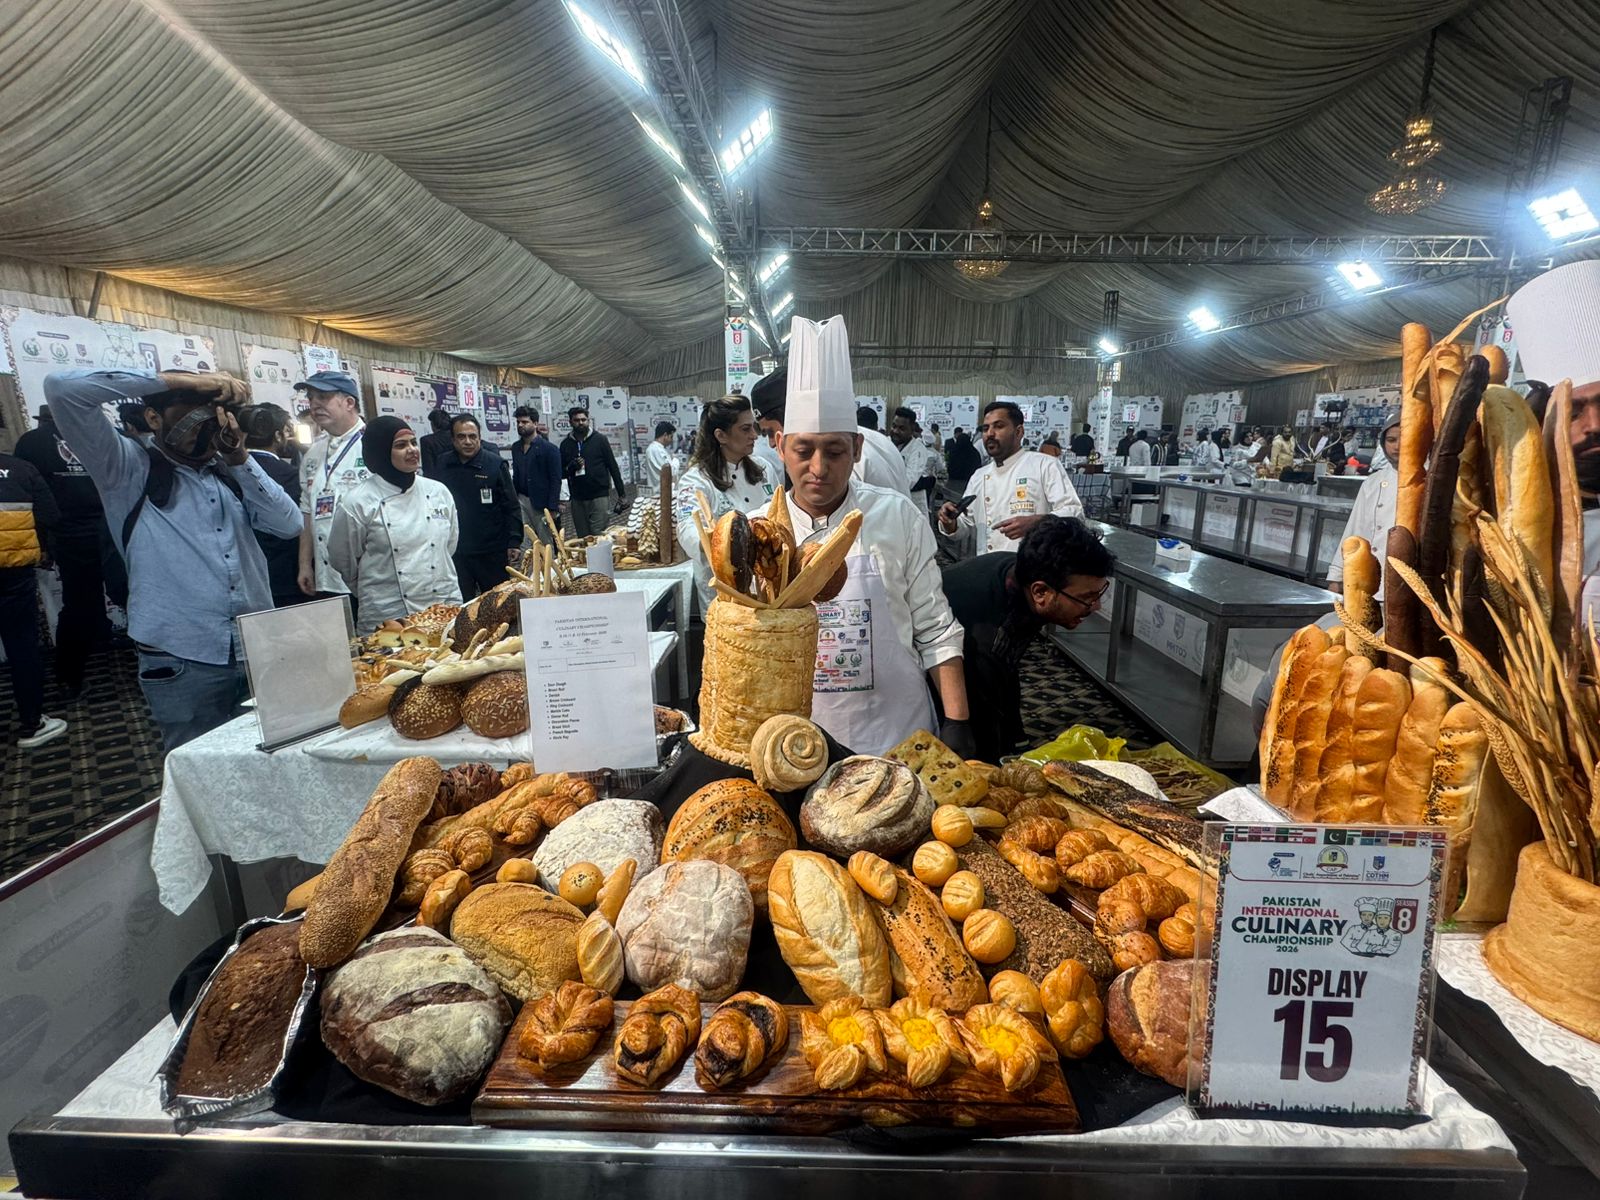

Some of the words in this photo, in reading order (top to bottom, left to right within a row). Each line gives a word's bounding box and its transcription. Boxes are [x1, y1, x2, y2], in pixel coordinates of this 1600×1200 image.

[735, 334, 740, 344] 8
[1504, 332, 1510, 342] 8
[145, 351, 155, 369] 8
[464, 390, 474, 406] 09
[1128, 412, 1136, 420] 15
[1262, 896, 1321, 907] PAKISTAN
[1242, 906, 1339, 918] INTERNATIONAL
[1231, 916, 1348, 936] CULINARY
[1397, 908, 1412, 932] 8
[1243, 934, 1334, 946] CHAMPIONSHIP
[1267, 968, 1368, 998] DISPLAY
[1273, 1000, 1354, 1083] 15
